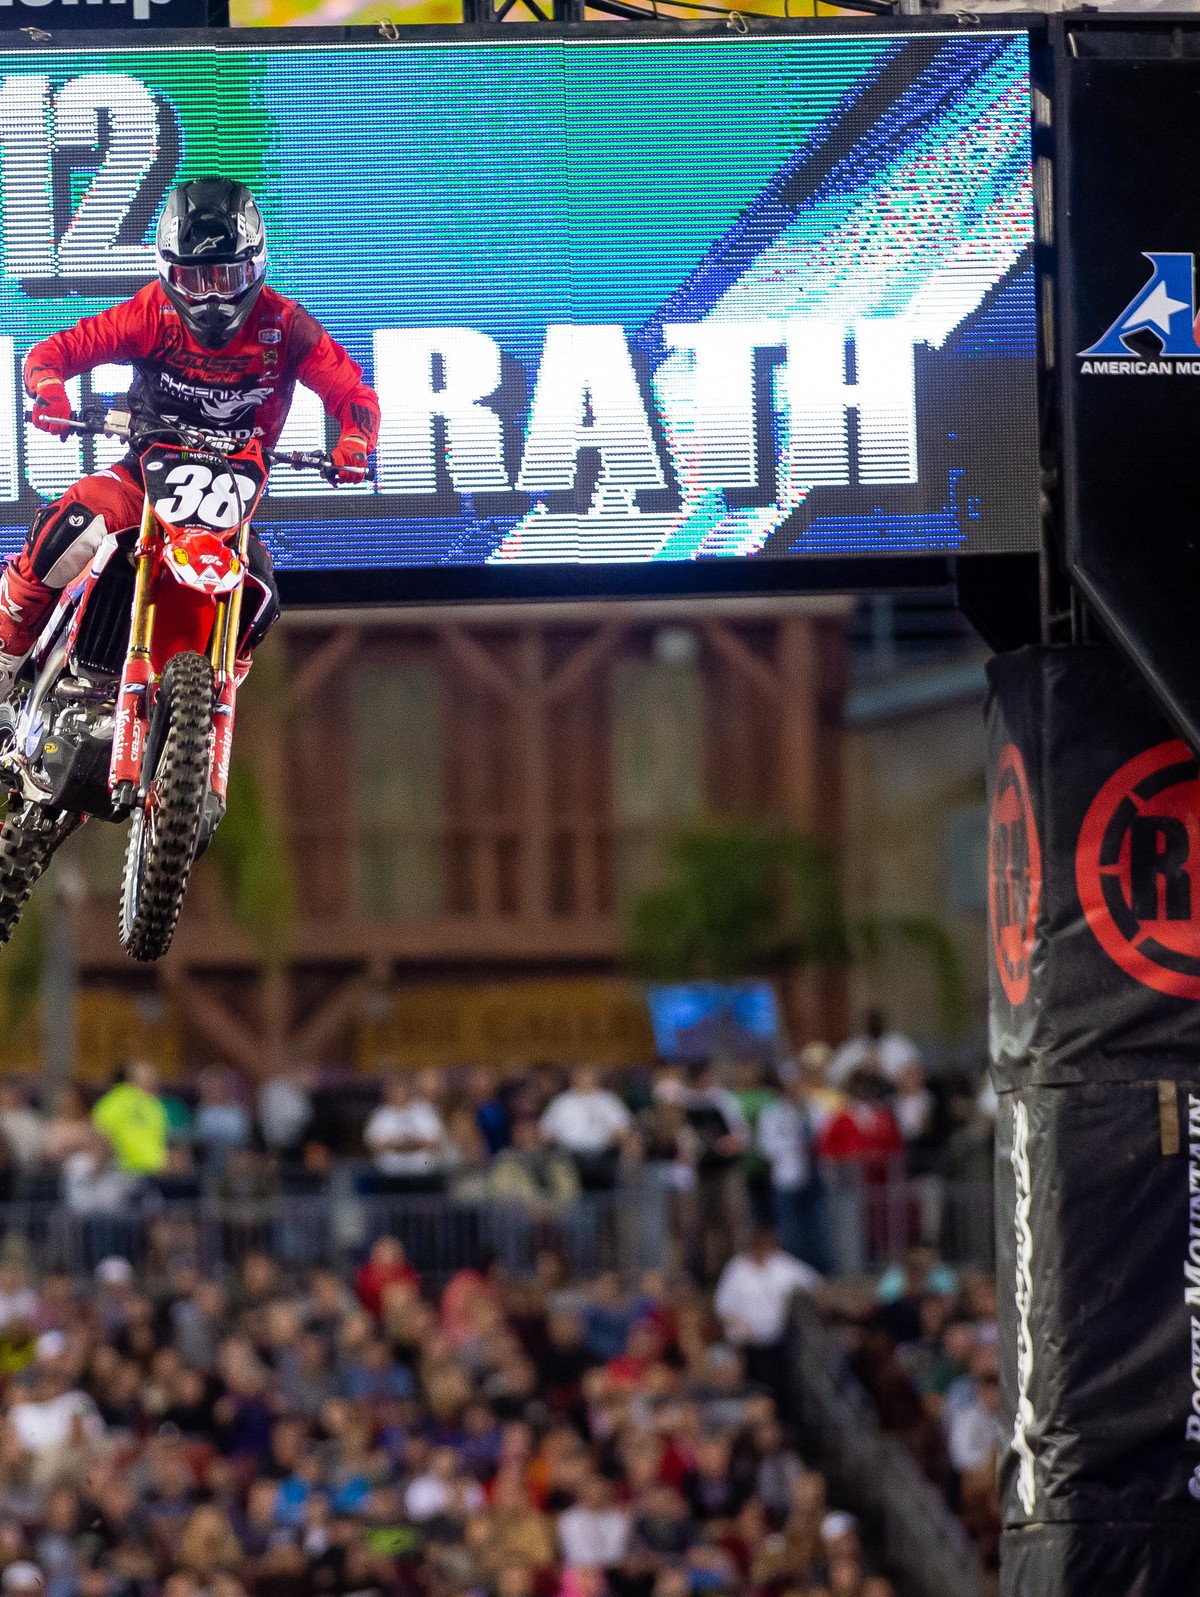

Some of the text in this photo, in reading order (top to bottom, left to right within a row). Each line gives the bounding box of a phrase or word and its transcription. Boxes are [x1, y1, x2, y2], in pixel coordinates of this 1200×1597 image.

[1080, 361, 1172, 374] AMERICAN
[160, 372, 244, 401] PHOENIX
[189, 452, 229, 463] MONSTE
[154, 464, 257, 528] 38
